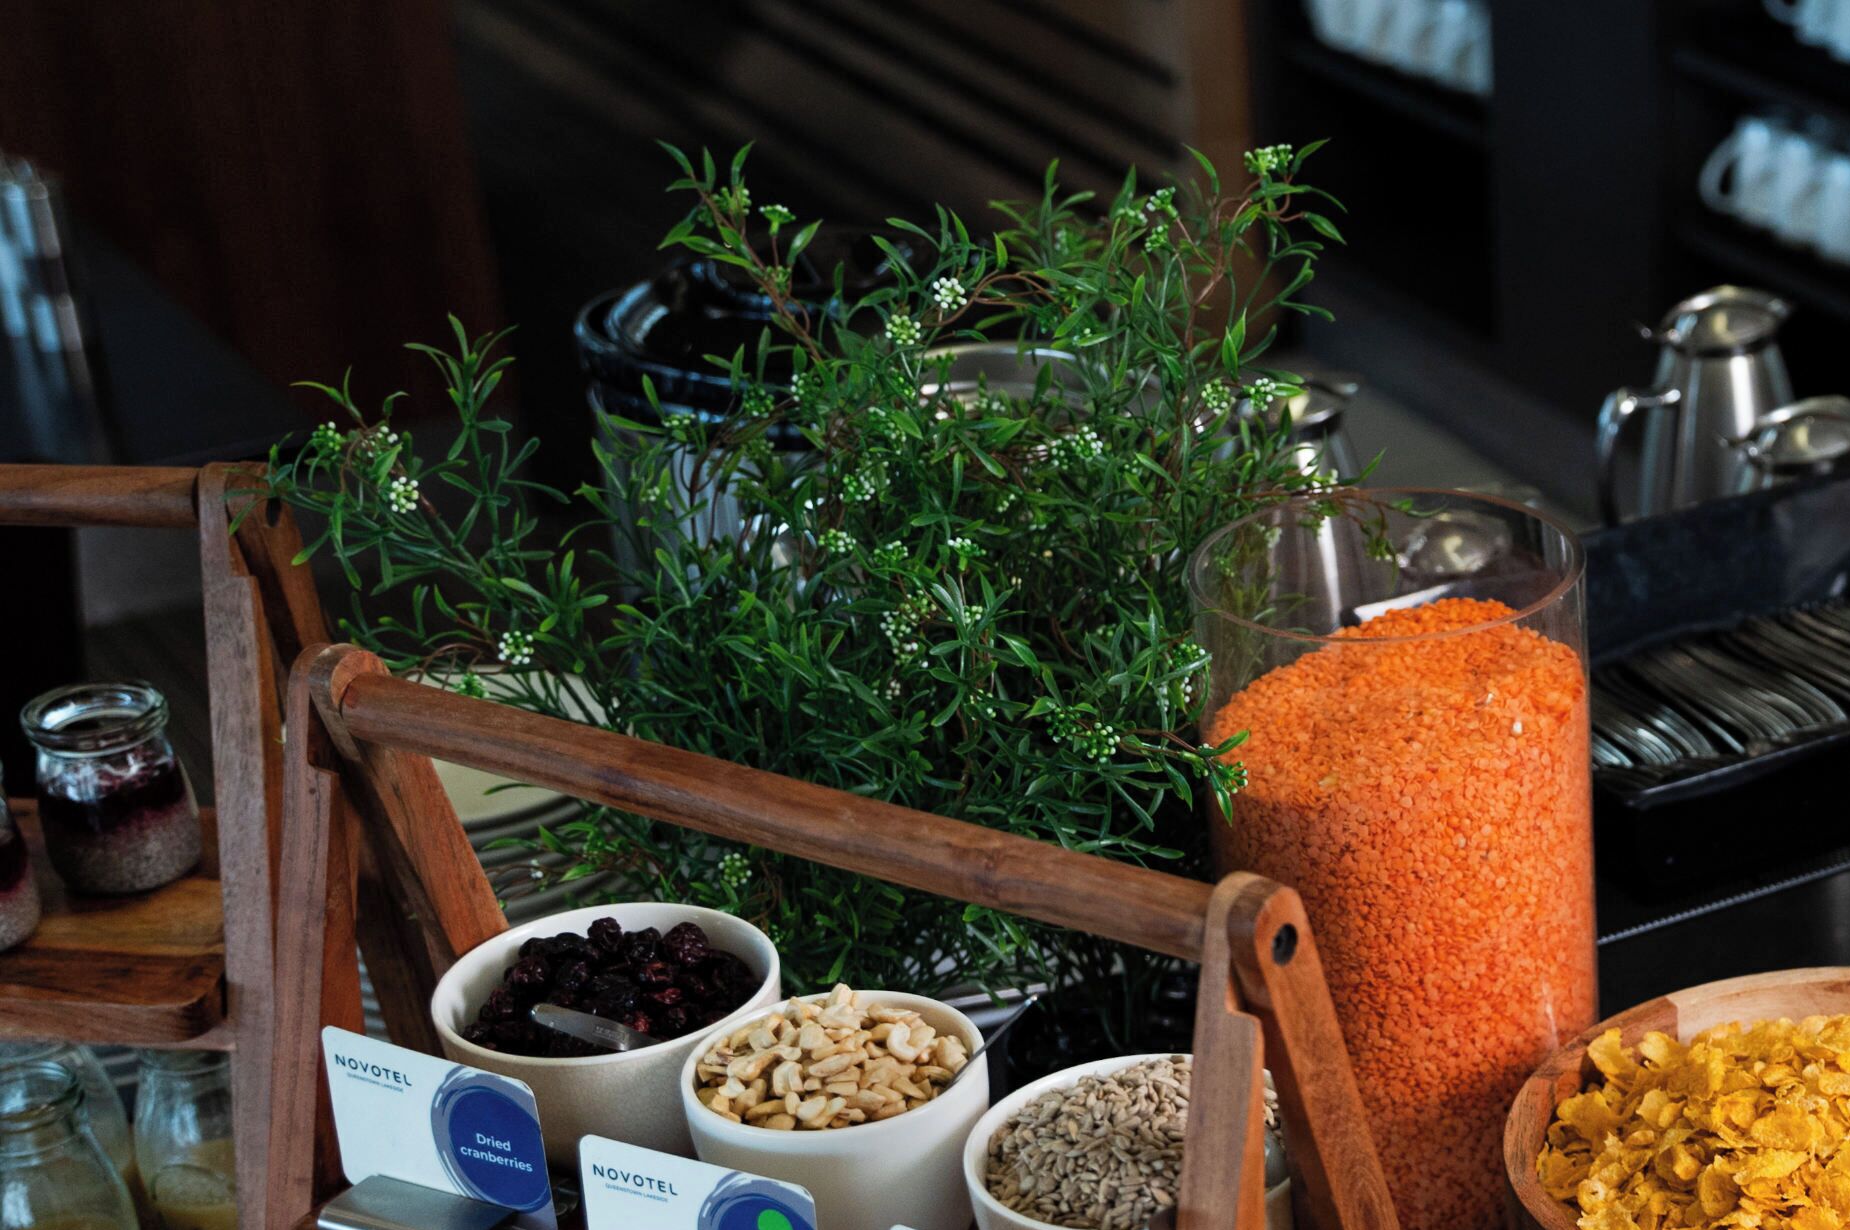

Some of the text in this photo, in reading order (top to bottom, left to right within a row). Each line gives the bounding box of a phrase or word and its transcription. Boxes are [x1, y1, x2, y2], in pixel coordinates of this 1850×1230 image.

[335, 1053, 412, 1087] NOVOTEL
[476, 1133, 511, 1152] Dried
[460, 1145, 533, 1173] cranberries
[592, 1163, 678, 1196] NOVOTEL
